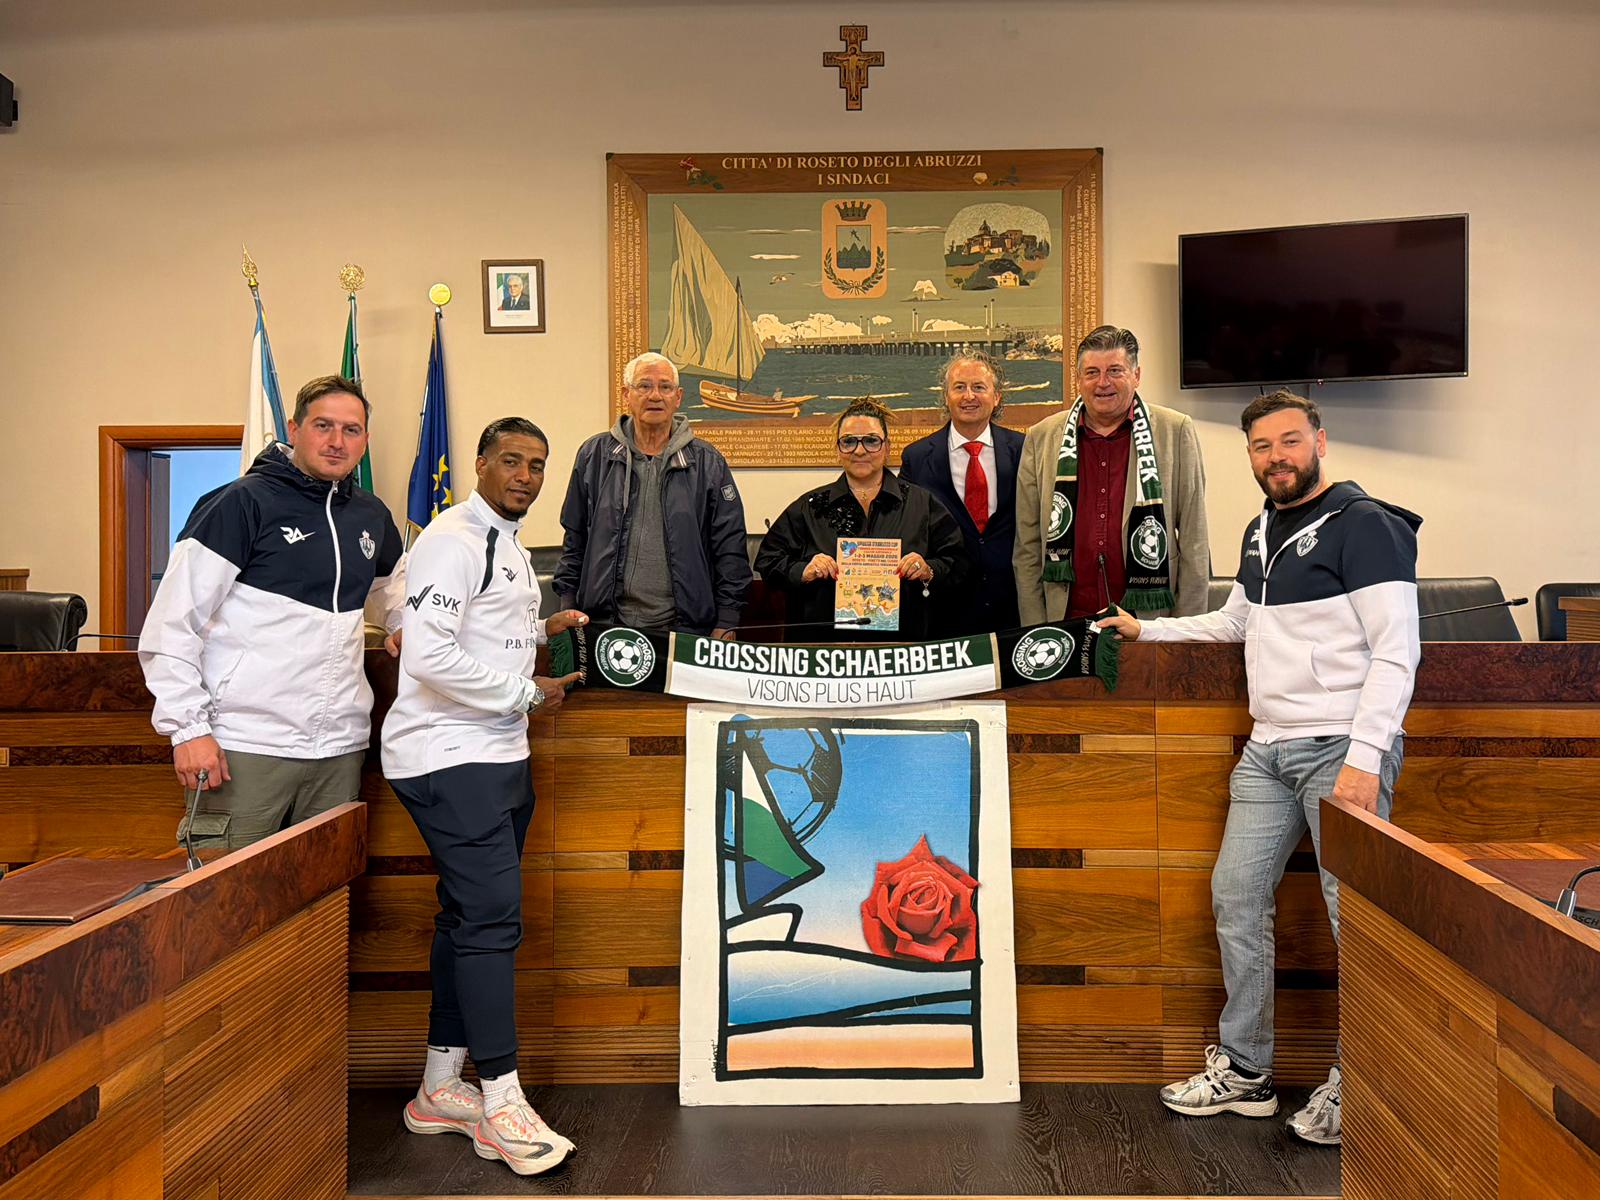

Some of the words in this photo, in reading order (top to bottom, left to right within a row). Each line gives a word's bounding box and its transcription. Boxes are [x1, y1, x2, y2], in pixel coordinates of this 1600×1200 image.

[722, 157, 772, 169] CITTA'
[776, 157, 792, 169] DI
[797, 156, 859, 169] ROSETO
[863, 155, 911, 168] DEGLI
[914, 154, 982, 167] ABRUZZI
[817, 173, 823, 185] I
[827, 173, 890, 185] SINDACI
[432, 593, 461, 613] SVK
[505, 638, 523, 650] P.B.
[633, 637, 652, 681] CROSSING
[694, 637, 809, 676] CROSSING
[815, 640, 973, 677] SCHAERBEEK
[1015, 636, 1034, 676] CROSSING
[747, 678, 811, 703] VISONS
[815, 682, 861, 703] PLUS
[867, 680, 916, 701] HAUT
